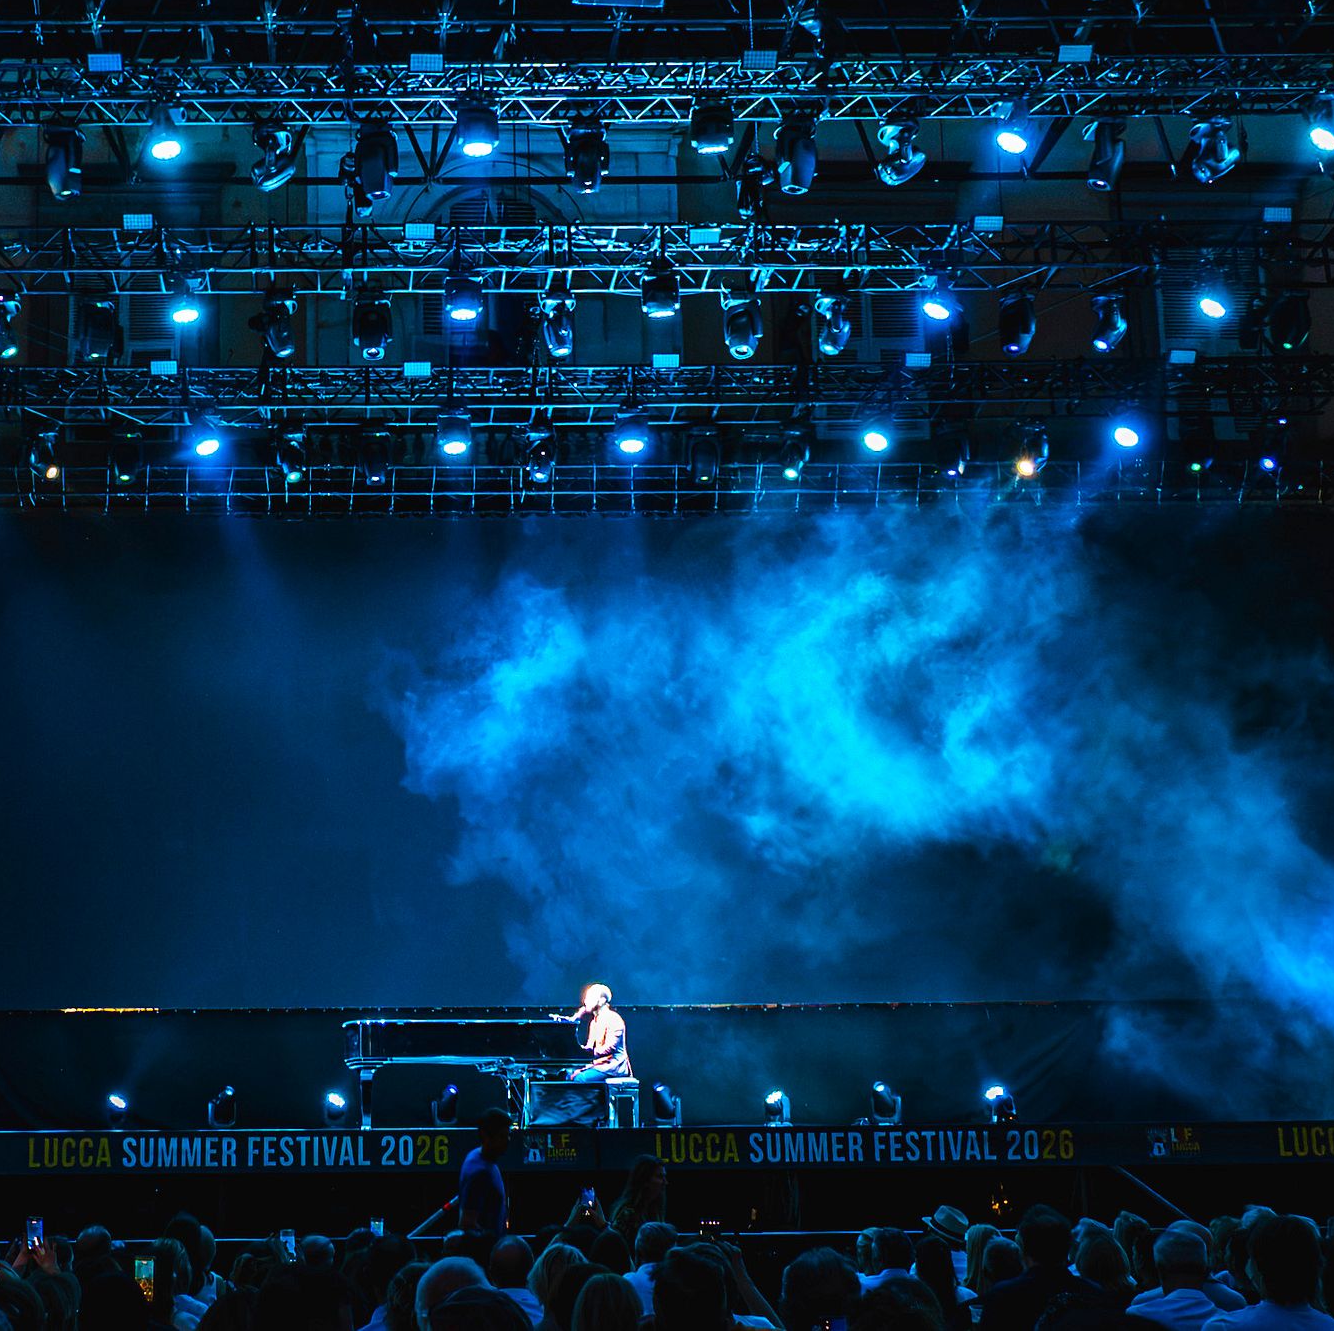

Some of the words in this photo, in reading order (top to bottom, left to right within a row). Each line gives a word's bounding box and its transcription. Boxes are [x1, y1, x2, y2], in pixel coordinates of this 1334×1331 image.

[27, 1137, 112, 1168] LUCCA
[122, 1136, 237, 1167] SUMMER
[247, 1135, 371, 1167] FESTIVAL
[381, 1135, 449, 1166] 2026
[655, 1132, 740, 1163] LUCCA
[748, 1131, 864, 1162] SUMMER
[873, 1130, 997, 1162] FESTIVAL
[1006, 1129, 1075, 1160] 2026
